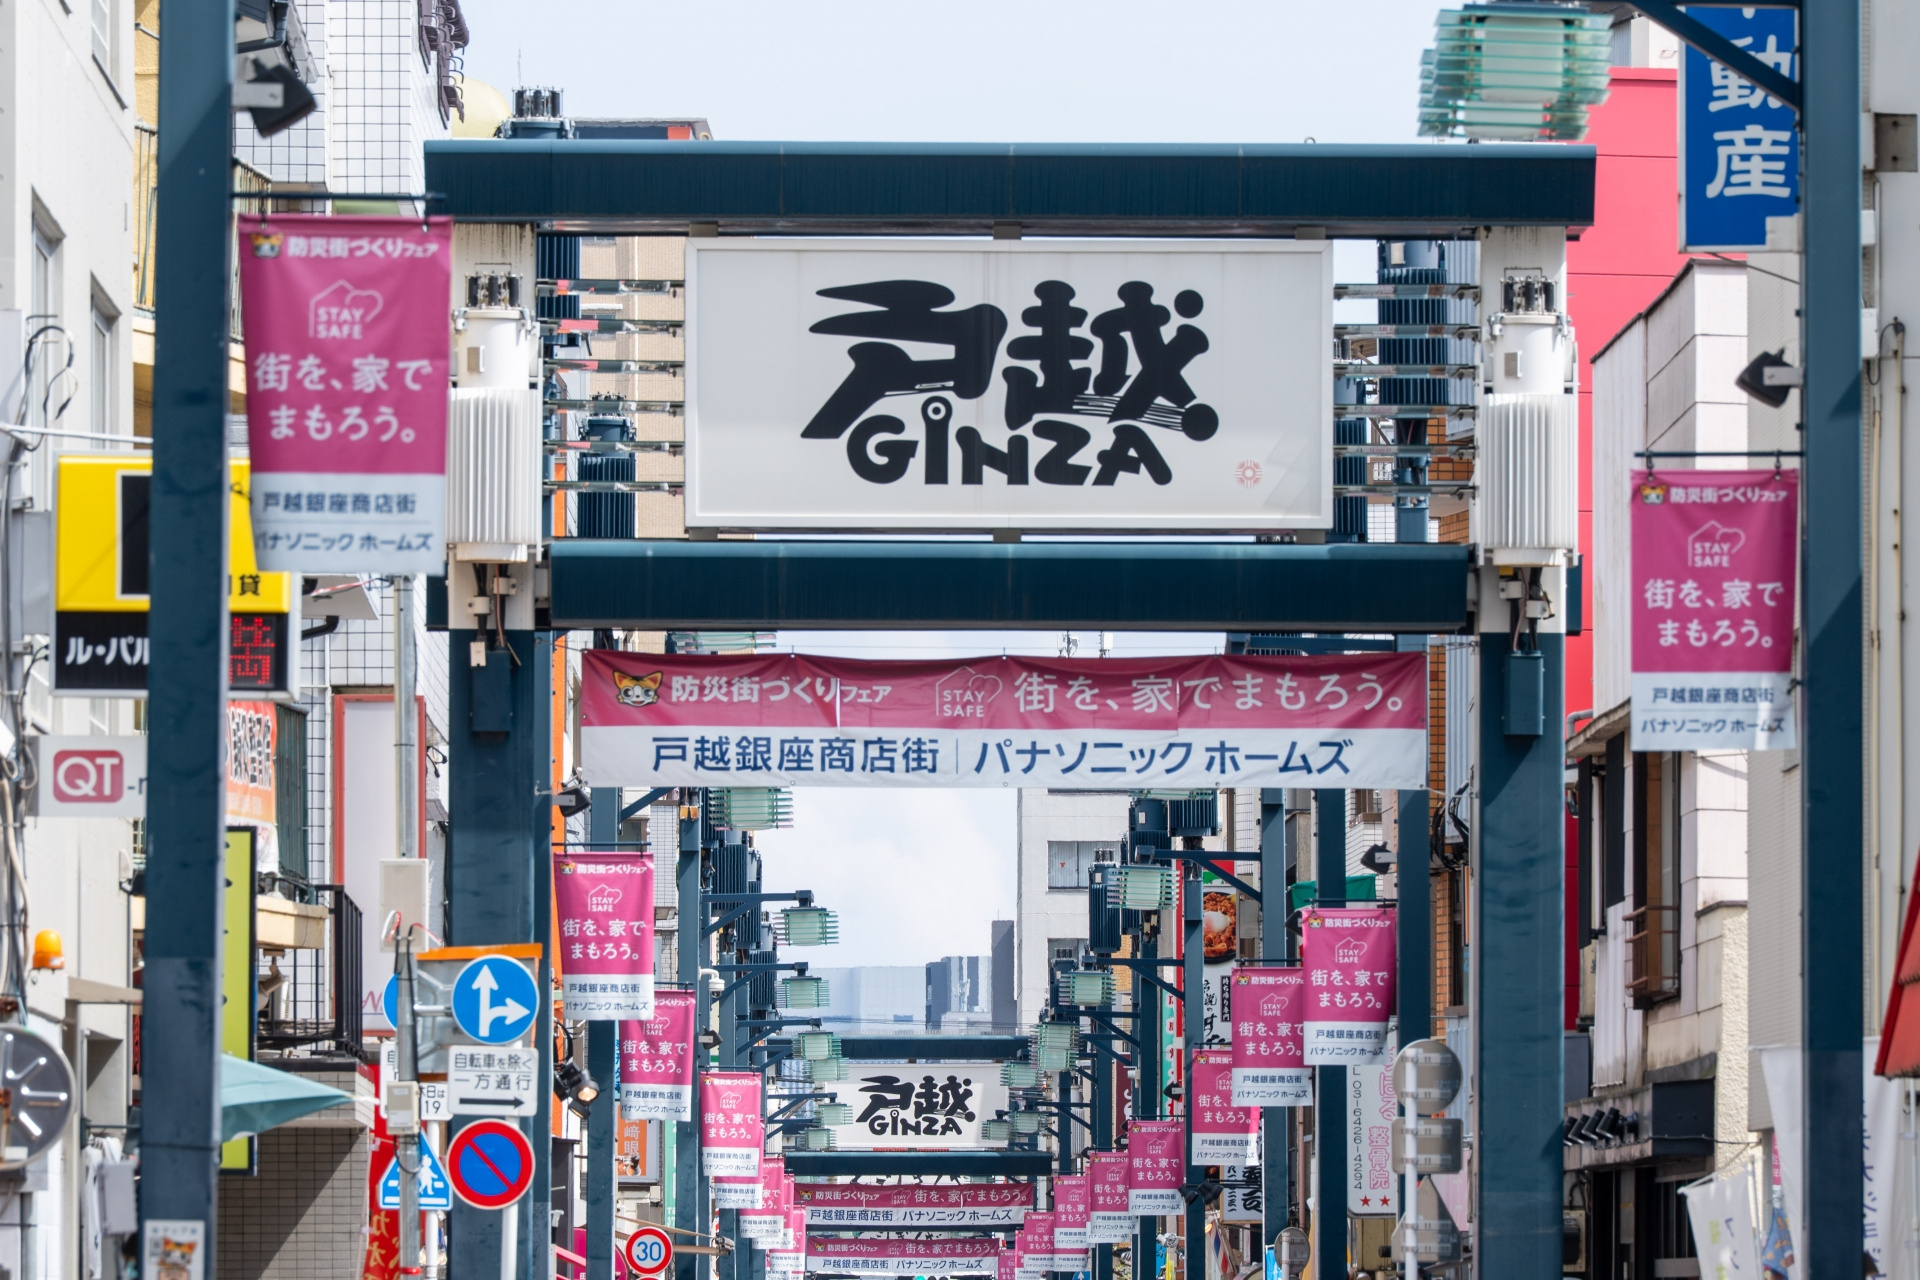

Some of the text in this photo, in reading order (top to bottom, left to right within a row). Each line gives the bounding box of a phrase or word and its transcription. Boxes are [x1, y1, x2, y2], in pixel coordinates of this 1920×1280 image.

[1705, 8, 1792, 199] 動産
[287, 236, 439, 259] 防災街づくりフェア
[317, 308, 364, 322] STAY
[317, 325, 363, 339] SAFE
[801, 280, 1219, 440] 戸越
[254, 354, 433, 393] 街を、家で
[270, 405, 415, 444] まもろう。
[847, 396, 1173, 487] GINZA
[262, 492, 416, 514] 戸越銀座商店街
[1670, 487, 1788, 504] 防災街づくりフェア
[360, 532, 433, 551] ホームズ
[1695, 543, 1730, 554] STAY
[1694, 556, 1730, 567] SAFE
[230, 574, 261, 596] 貸
[1644, 579, 1784, 609] 街を、家で
[1658, 620, 1772, 648] まもろう。
[671, 676, 892, 704] 防災街づくりフェア
[943, 690, 986, 702] STAY
[1014, 672, 1402, 713] 街を、家でまもろう。
[1652, 687, 1775, 704] 戸越銀座商店街
[943, 704, 985, 718] SAFE
[1641, 718, 1784, 733] パナソニック ホームズ
[652, 736, 939, 774] 戸越銀座商店街
[577, 864, 647, 874] 防災街づくりフェア
[563, 919, 646, 936] 街を、家で
[1325, 918, 1391, 928] 防災街づくりフェア
[571, 943, 639, 960] まもろう。
[1311, 970, 1389, 986] 街を、家で
[569, 983, 640, 993] 戸越銀座商店街
[566, 1001, 648, 1011] パナソニック ホームズ
[1319, 992, 1382, 1008] まもろう。
[1316, 1029, 1381, 1040] 戸越銀座商店街
[1245, 1042, 1302, 1056] まもろう。
[1310, 1047, 1384, 1056] パナソニック ホームズ
[455, 1053, 533, 1069] 自転車を除く
[454, 1074, 532, 1091] 一方通行
[1243, 1075, 1302, 1084] 戸越銀座商店街
[856, 1075, 976, 1123] 戸越
[1237, 1090, 1308, 1099] パナソニック ホームズ
[868, 1109, 962, 1135] GINZA
[1369, 1125, 1389, 1189] 整骨院
[815, 1191, 880, 1200] 防災街づくりフェア
[914, 1189, 1026, 1203] 街を、家でまもろう。
[810, 1210, 893, 1221] 戸越銀座商店街
[636, 1241, 662, 1262] 30
[823, 1259, 888, 1269] 戸越銀座商店街
